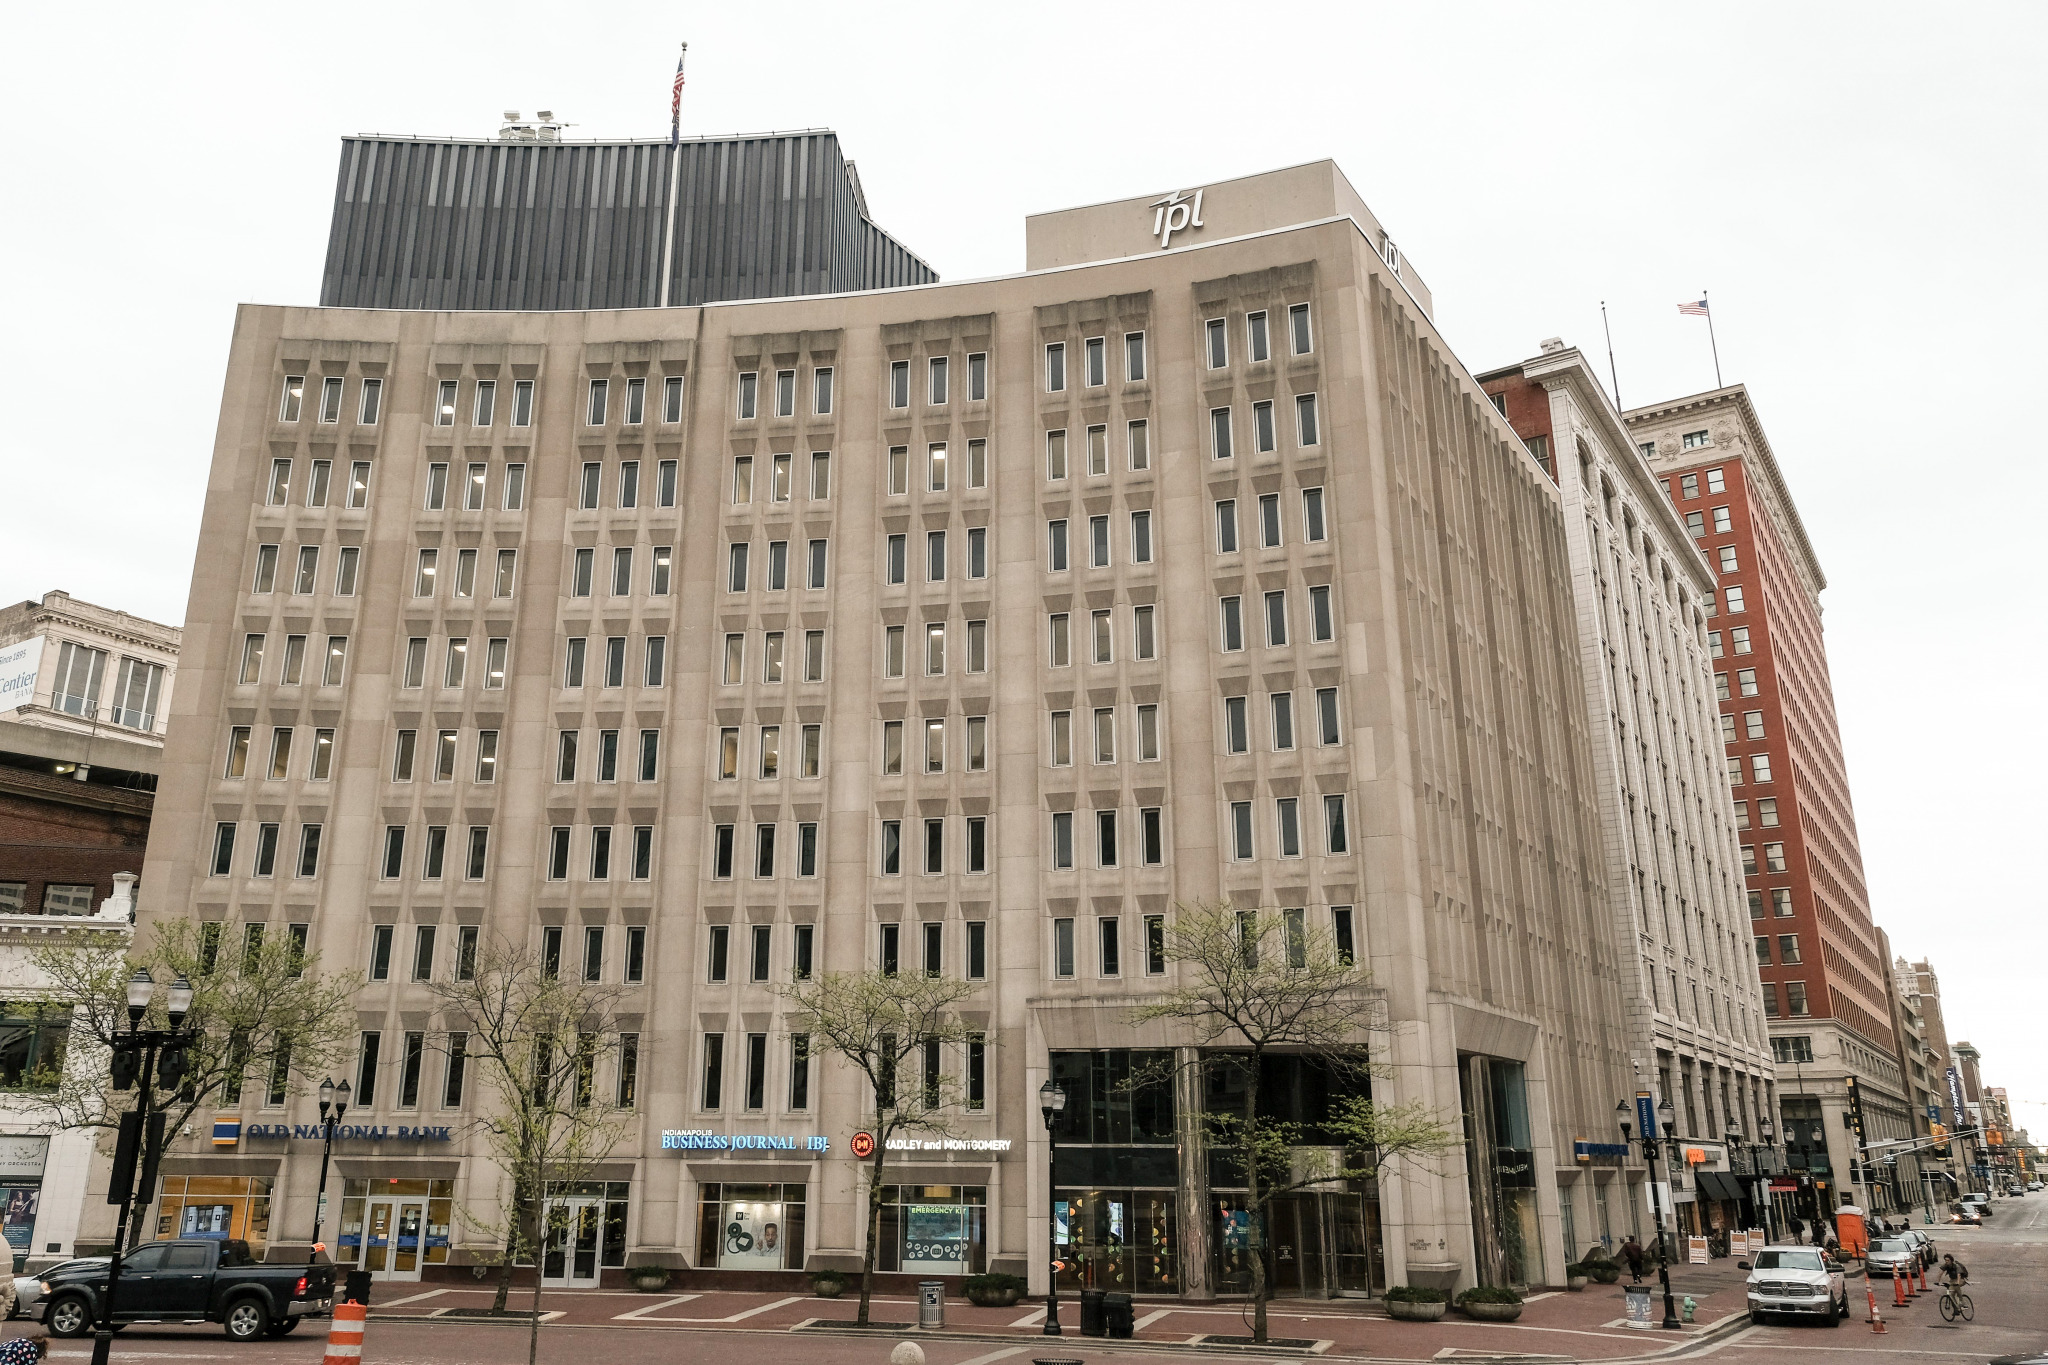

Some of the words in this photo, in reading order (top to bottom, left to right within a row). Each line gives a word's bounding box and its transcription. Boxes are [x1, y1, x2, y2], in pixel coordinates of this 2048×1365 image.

[1152, 189, 1204, 248] ipl
[247, 1124, 289, 1139] OLD
[293, 1125, 389, 1140] NATIONAL
[398, 1126, 452, 1141] BANK
[661, 1135, 728, 1149] BUSINESS
[730, 1135, 796, 1152] JOURNAL
[807, 1136, 828, 1152] IBJ
[882, 1139, 922, 1150] RADLEY
[923, 1140, 941, 1150] and
[944, 1140, 1012, 1150] MONTGOMERY
